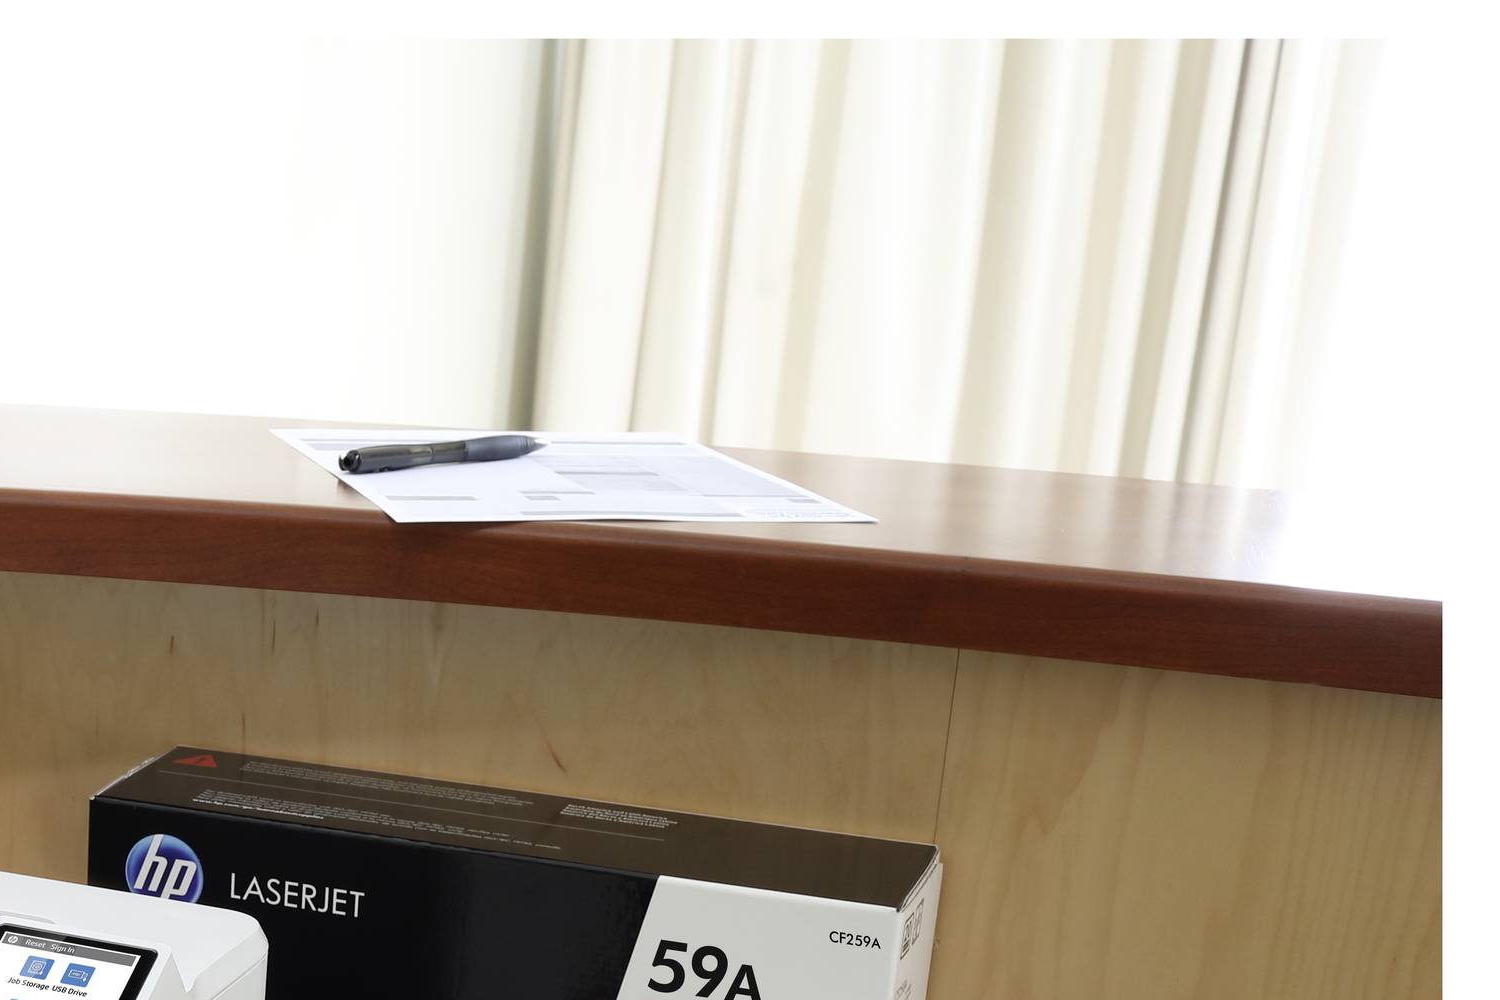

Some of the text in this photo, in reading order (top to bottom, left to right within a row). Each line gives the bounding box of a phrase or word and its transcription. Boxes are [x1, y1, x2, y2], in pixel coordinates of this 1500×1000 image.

[134, 834, 197, 900] hp
[230, 872, 365, 917] LASERJET
[25, 939, 46, 948] Reset
[829, 931, 881, 949] CF259A
[50, 943, 66, 952] Sign
[21, 980, 49, 990] Storage
[52, 985, 87, 997] USB Drive
